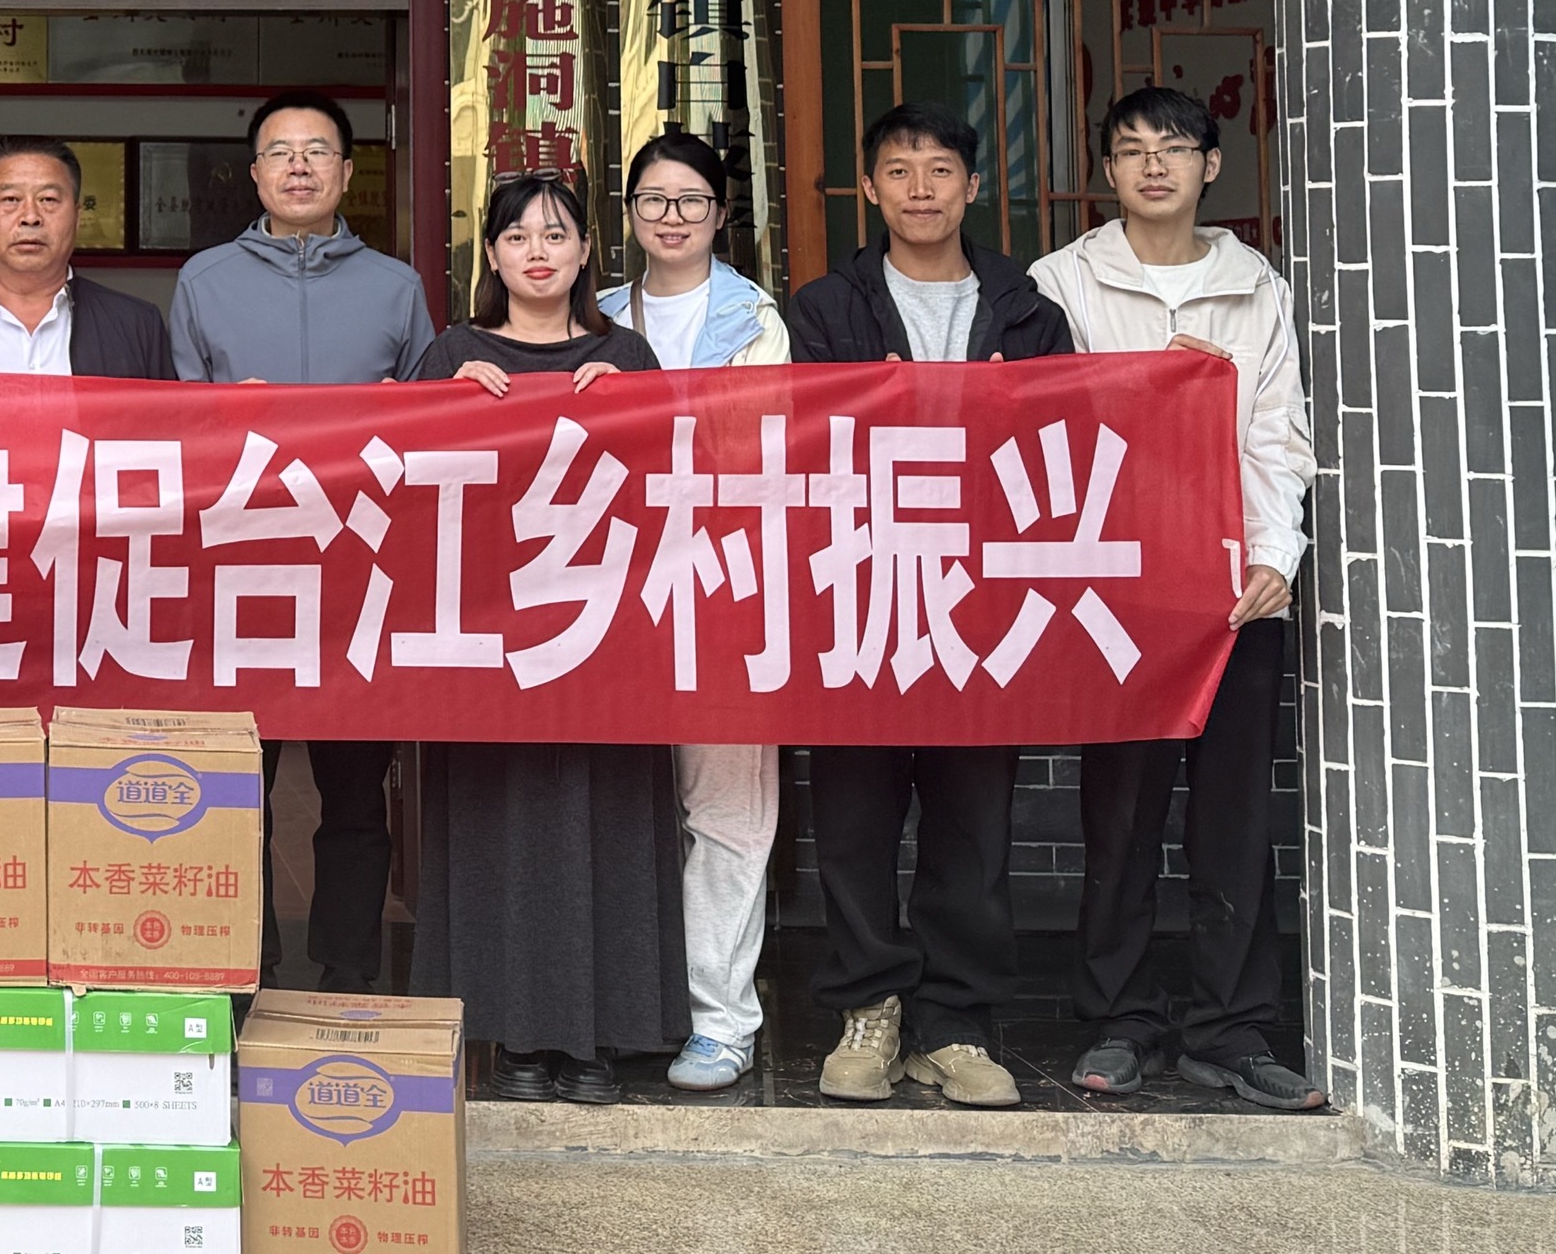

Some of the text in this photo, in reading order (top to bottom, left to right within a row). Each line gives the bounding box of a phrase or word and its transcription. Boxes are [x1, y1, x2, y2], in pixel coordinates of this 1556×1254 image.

[117, 780, 194, 805] 道道全
[68, 860, 239, 898] 本香菜籽油
[75, 922, 231, 937] 非转基因 物理压榨
[54, 1099, 66, 1107] A4
[162, 1100, 197, 1110] SHEETS
[307, 1081, 387, 1108] 道道全
[261, 1162, 436, 1206] 本香菜籽油
[269, 1225, 320, 1239] 非转基因
[377, 1230, 429, 1245] 物理压榨
